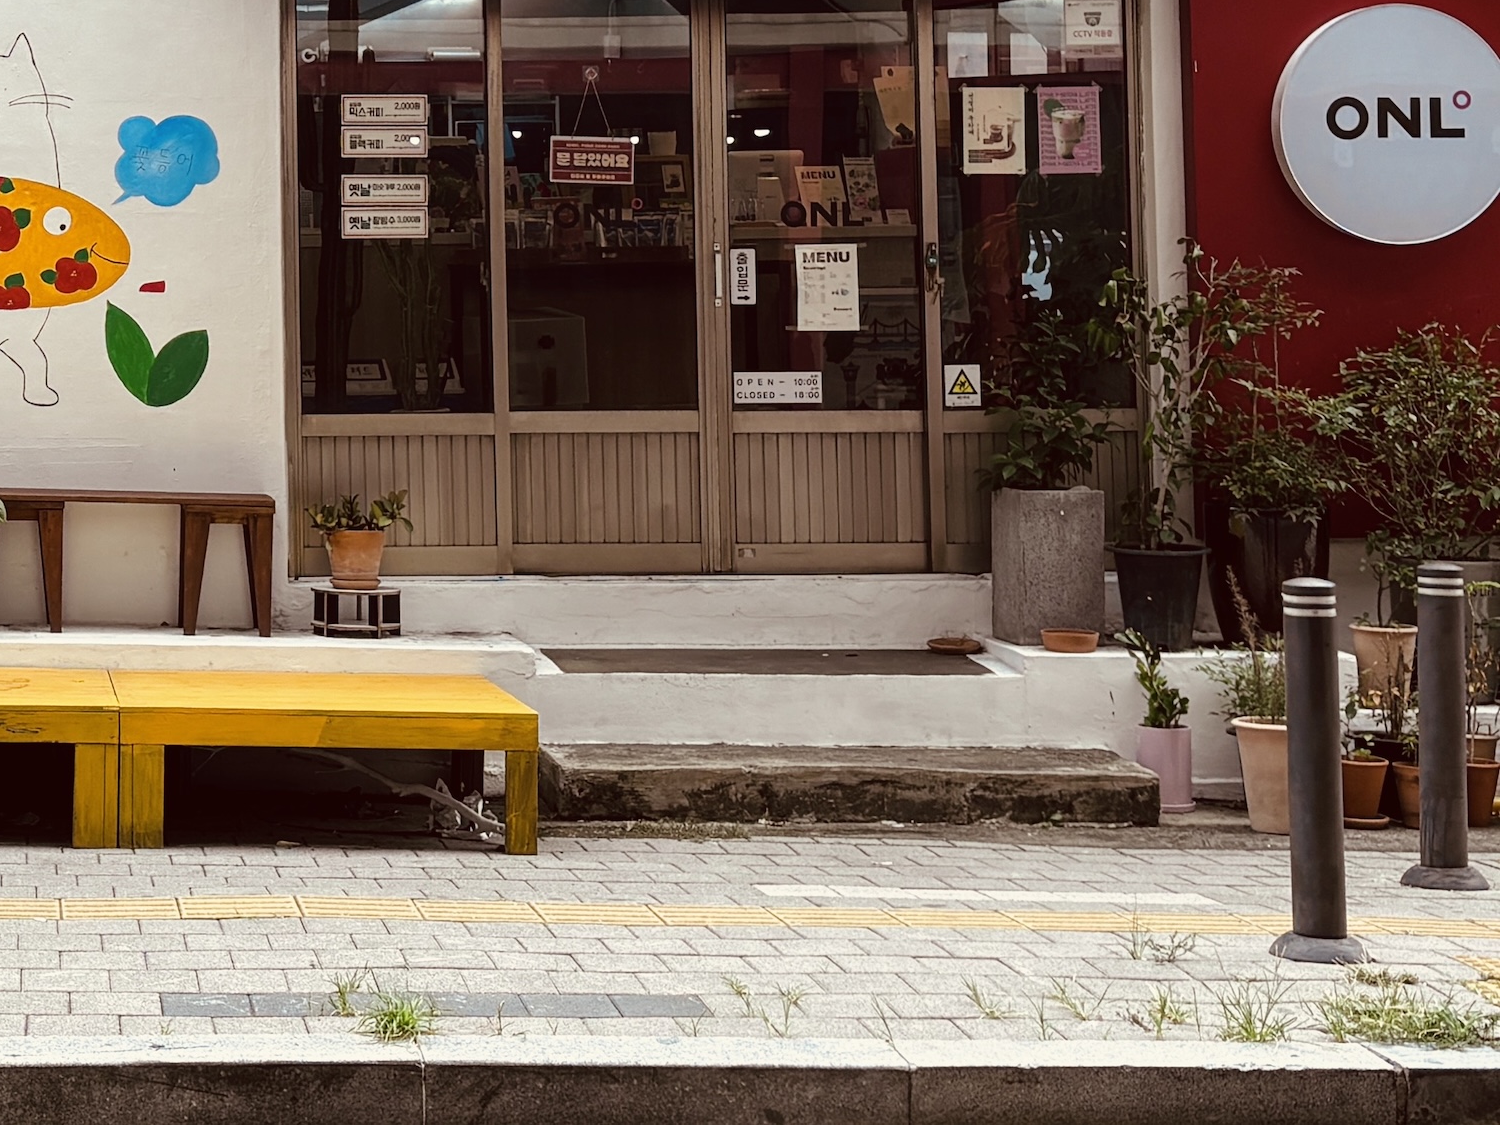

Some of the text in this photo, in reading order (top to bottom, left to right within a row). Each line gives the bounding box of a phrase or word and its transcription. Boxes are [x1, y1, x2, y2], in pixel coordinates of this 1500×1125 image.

[1072, 30, 1093, 38] CCTV
[349, 107, 384, 117] 믹스커피
[556, 151, 630, 168] 문 닫았어요
[801, 170, 837, 180] MENU
[349, 183, 372, 197] 옛날
[349, 216, 372, 230] 옛날
[802, 251, 850, 263] MENU
[736, 251, 749, 293] 출입문
[736, 378, 818, 386] OPEN 10:00
[736, 391, 776, 399] CLOSED
